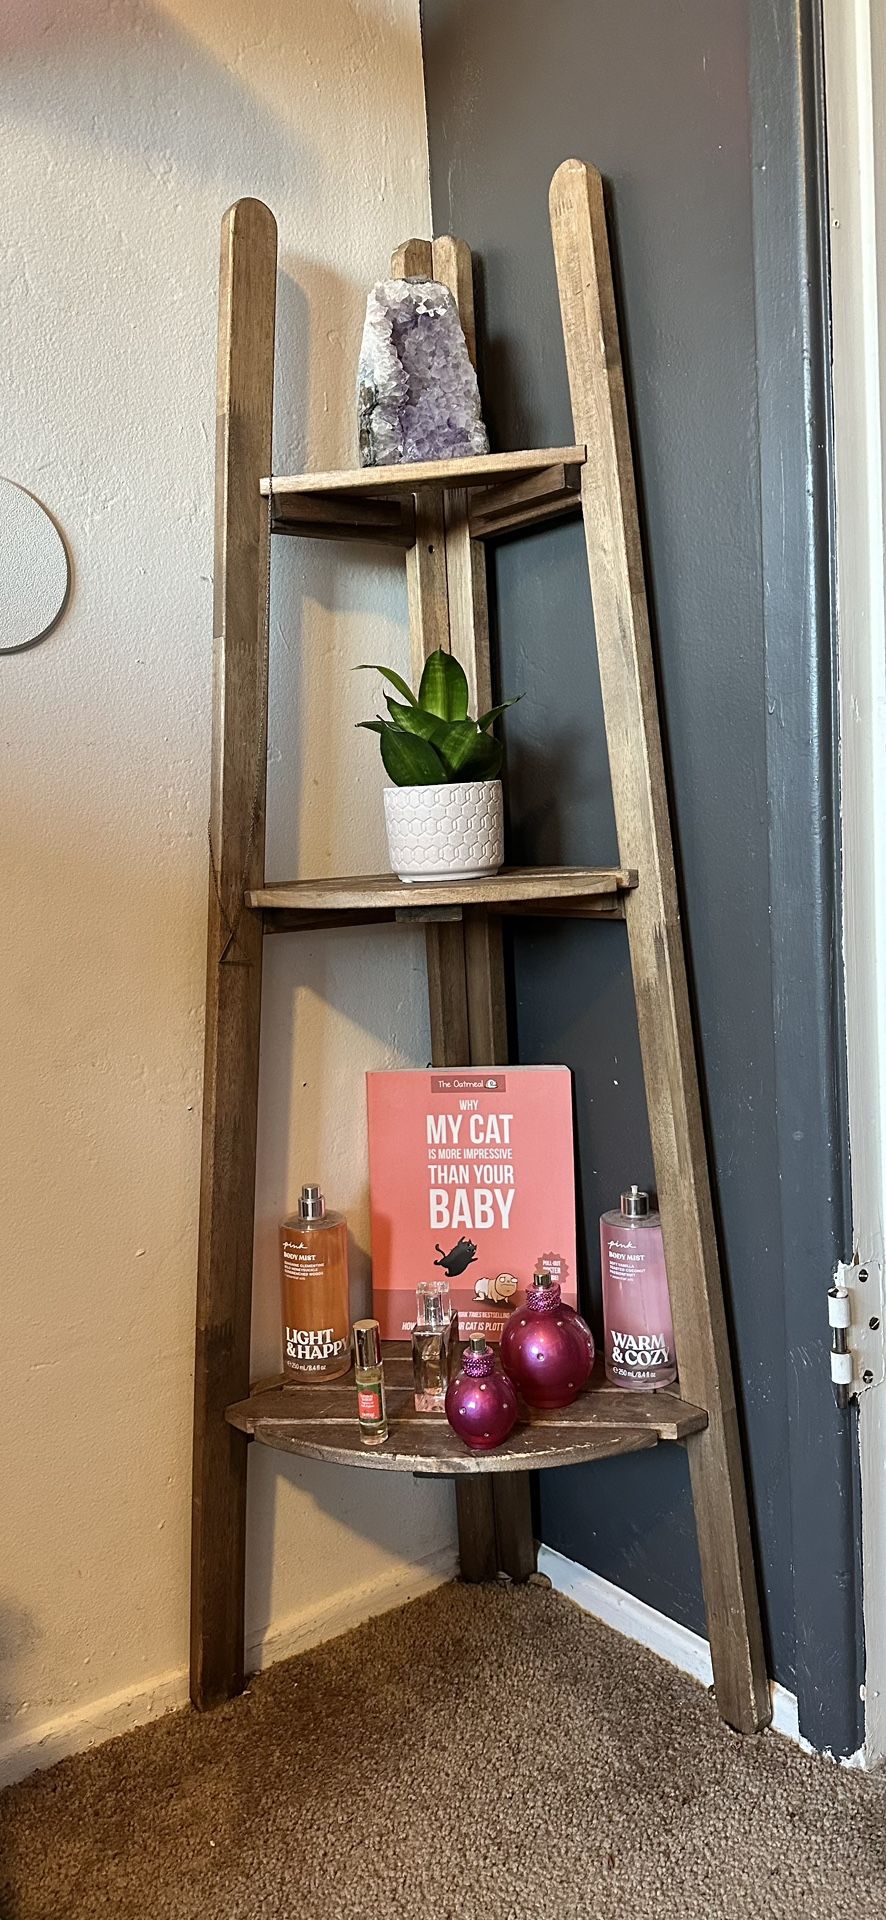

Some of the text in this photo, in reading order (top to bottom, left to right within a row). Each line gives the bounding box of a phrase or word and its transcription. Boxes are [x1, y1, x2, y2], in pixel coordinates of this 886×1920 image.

[438, 1079, 484, 1088] The Oatmeal
[459, 1099, 479, 1111] WHY
[426, 1114, 513, 1144] MY CAT
[428, 1149, 513, 1159] IS MORE IMPRESSIVE
[428, 1164, 514, 1184] THAN YOUR
[429, 1188, 515, 1229] BABY
[607, 1240, 637, 1250] pink
[283, 1251, 298, 1260] BODY
[608, 1251, 625, 1260] BODY
[465, 1321, 478, 1330] CAT
[477, 1321, 485, 1330] IS
[286, 1326, 334, 1346] LIGHT
[610, 1330, 666, 1351] WARM
